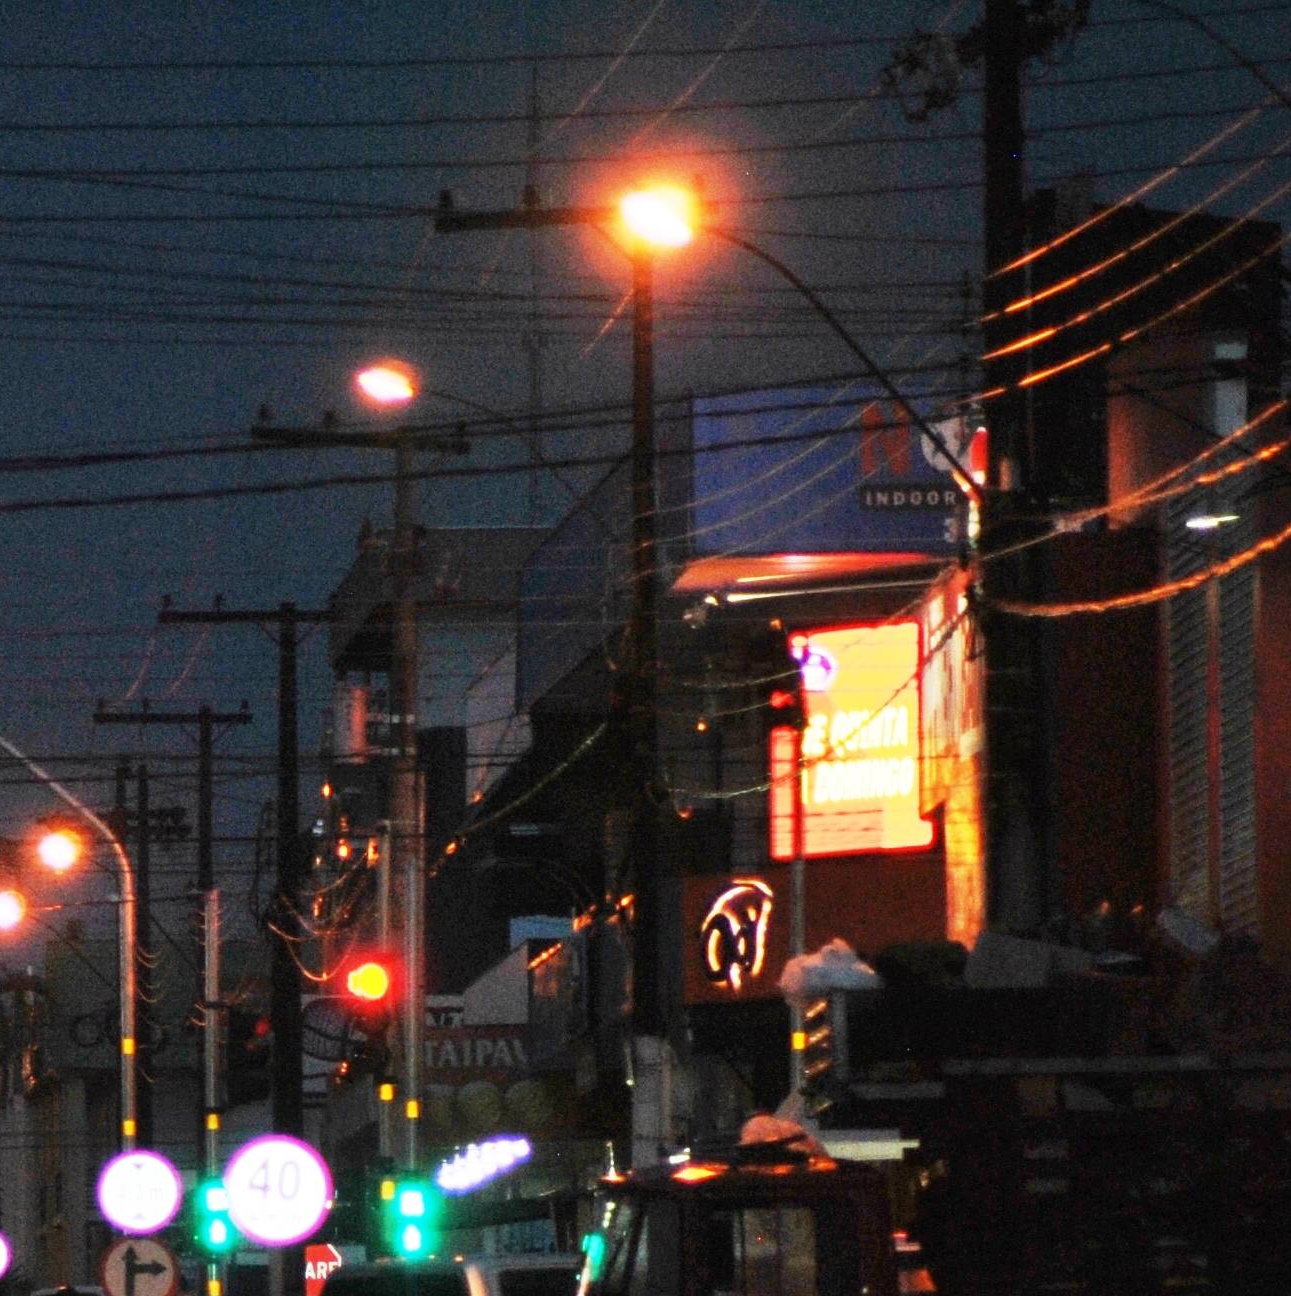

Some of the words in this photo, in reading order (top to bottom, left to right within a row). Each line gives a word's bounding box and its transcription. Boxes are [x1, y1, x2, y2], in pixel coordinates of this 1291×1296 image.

[865, 490, 957, 506] INDOOR
[814, 756, 916, 804] DOMINGO
[249, 1159, 300, 1201] 40
